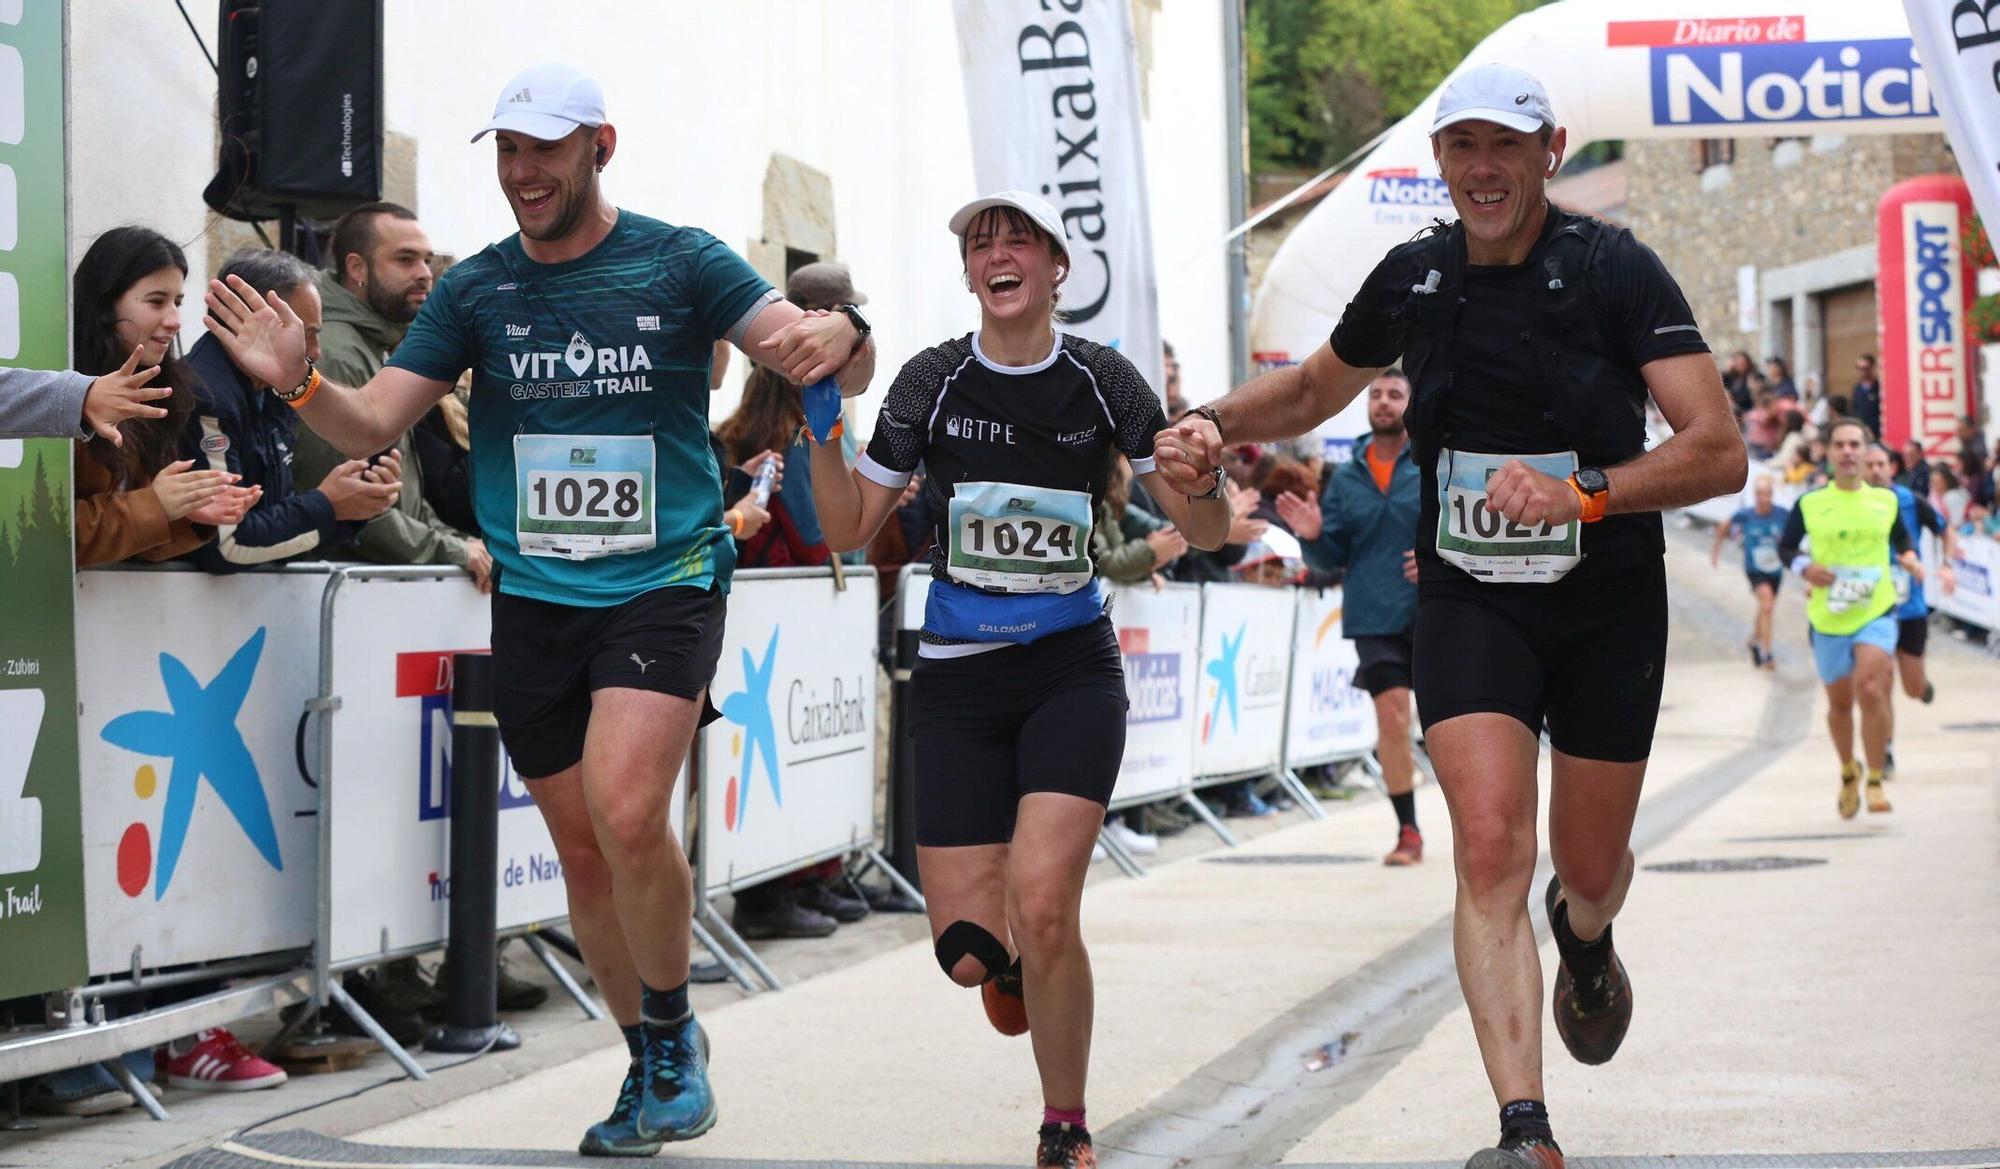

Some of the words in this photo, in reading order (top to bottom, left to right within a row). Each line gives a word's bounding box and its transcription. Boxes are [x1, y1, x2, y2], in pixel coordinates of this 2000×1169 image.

[1673, 19, 1760, 44] Diario
[1765, 17, 1800, 40] de
[1667, 46, 1934, 123] Notici
[1018, 0, 1111, 326] CaixaB
[1373, 178, 1450, 205] Notic
[505, 324, 532, 336] Vital
[1914, 220, 1959, 470] NTERSPORT
[509, 331, 653, 380] VITORIA
[510, 380, 590, 400] GASTEIZ
[593, 376, 653, 396] TRAIL
[962, 417, 1016, 445] GTPE
[533, 477, 640, 518] 1028
[968, 518, 1073, 558] 1024
[978, 621, 1037, 634] SALOMON
[788, 675, 866, 745] CaixaBank
[504, 858, 524, 888] de
[530, 853, 566, 884] Nav
[5, 883, 43, 919] Trail
